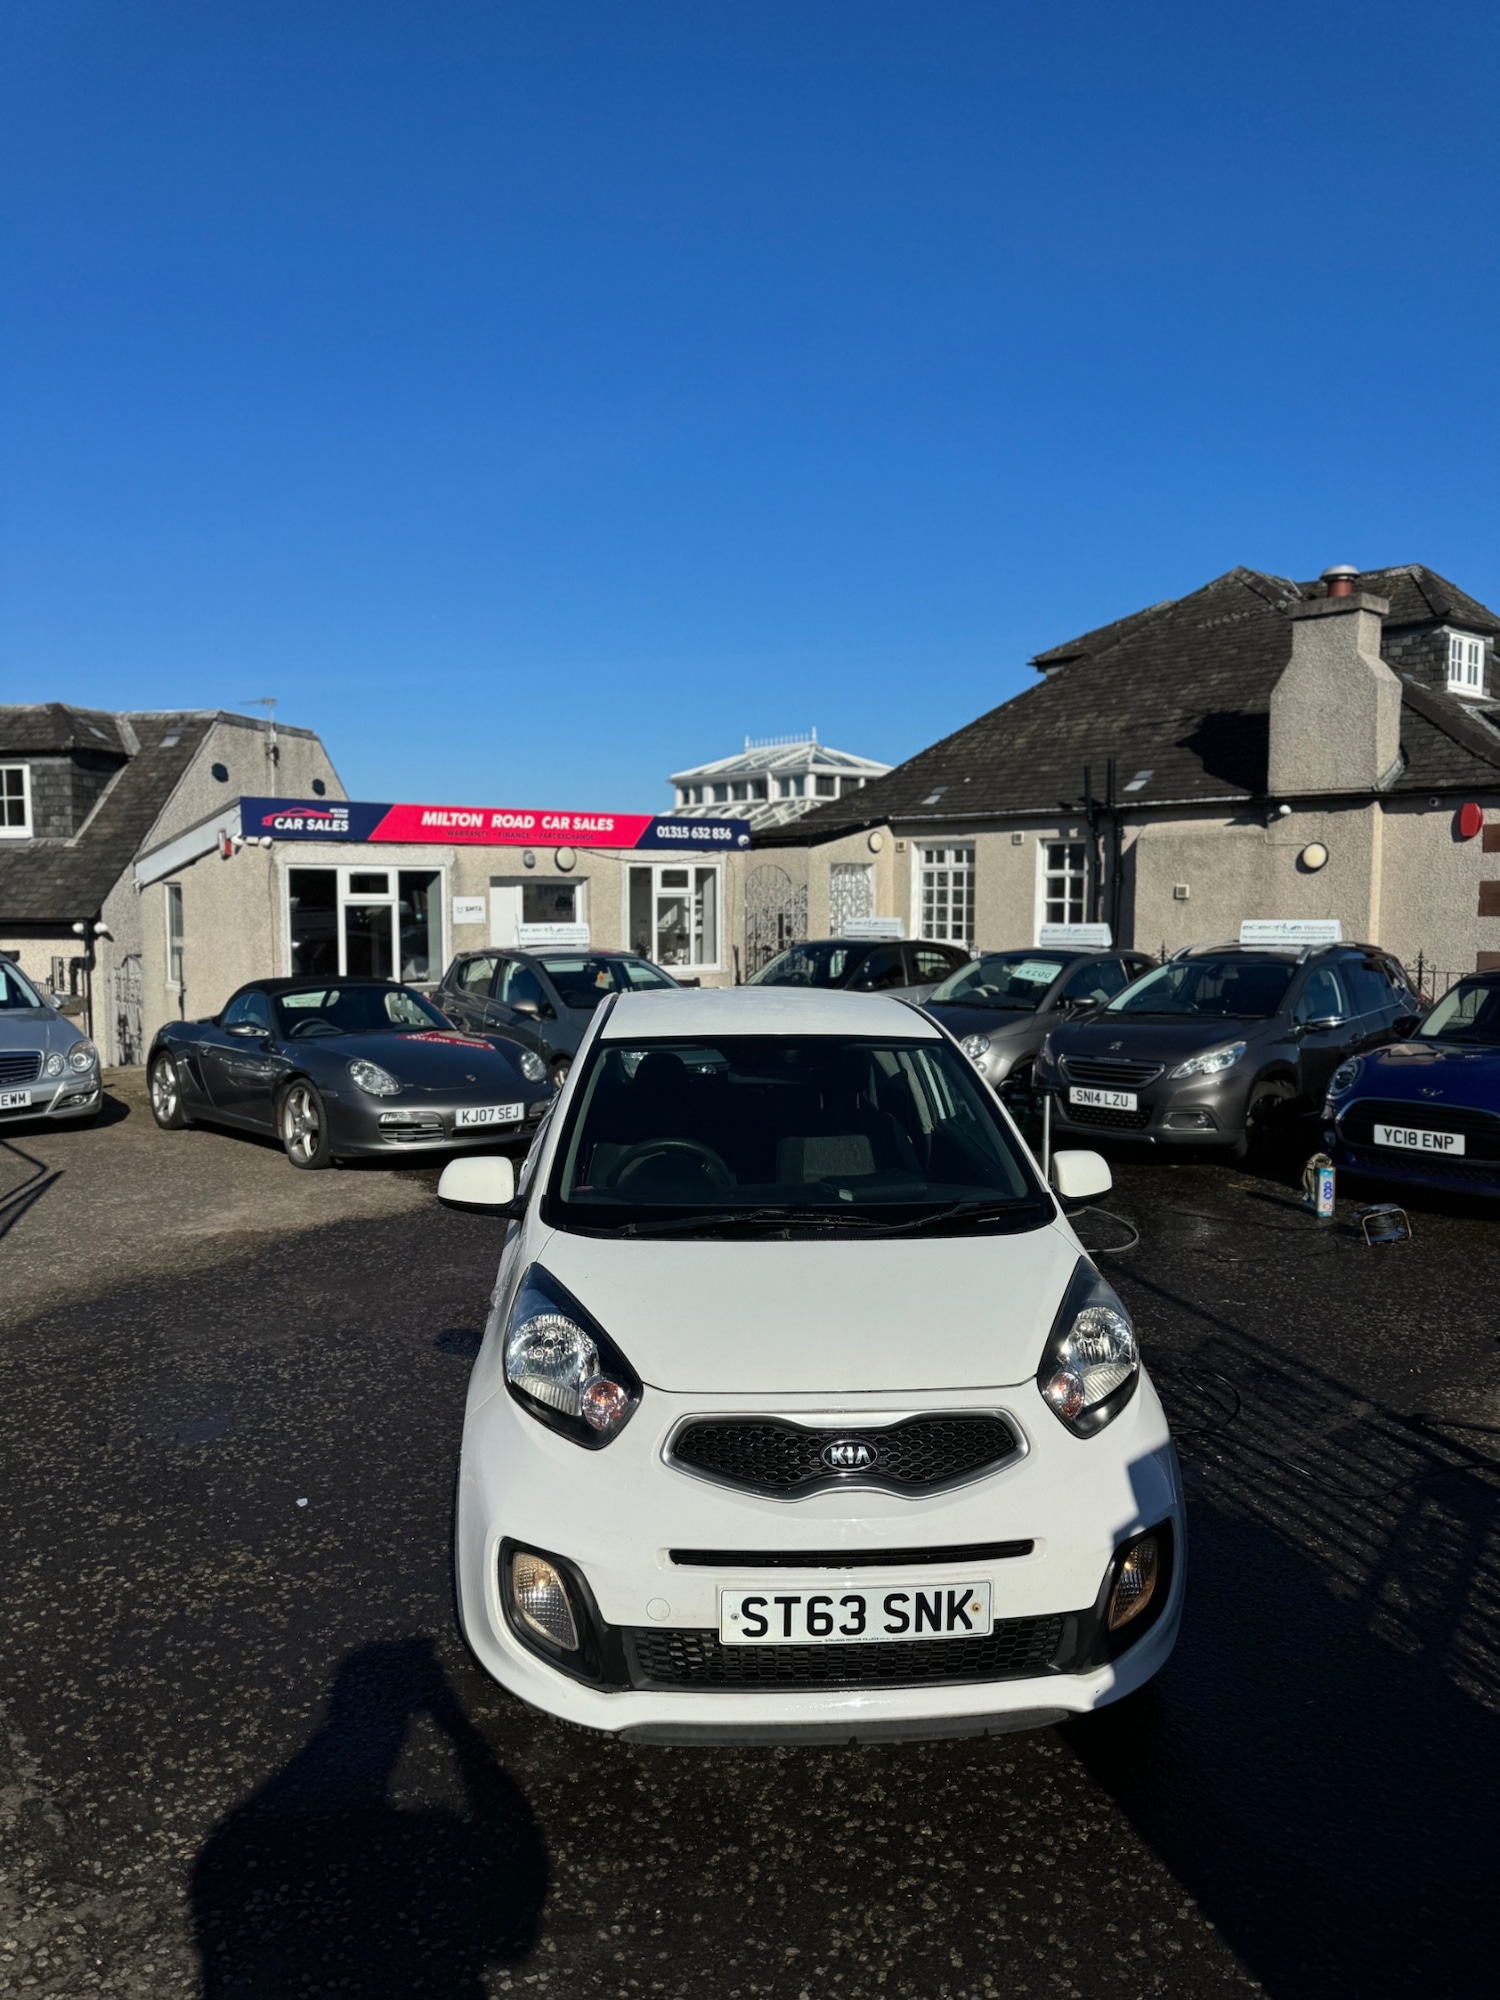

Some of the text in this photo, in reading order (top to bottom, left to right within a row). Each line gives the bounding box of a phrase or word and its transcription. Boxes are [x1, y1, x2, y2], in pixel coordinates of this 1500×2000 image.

[274, 817, 349, 832] CAR SALES
[421, 811, 614, 832] MILTON ROAD CAR SALES
[447, 829, 594, 841] WARRANTY FINANCE PART EXCHANGE
[656, 825, 732, 840] 01315 632 836
[1, 1092, 27, 1106] EWM
[1076, 1089, 1129, 1107] SN14 LZU
[462, 1105, 519, 1123] KJ07 SEJ
[1383, 1127, 1455, 1150] YC18 ENP
[830, 1446, 871, 1465] KIA
[741, 1588, 974, 1638] ST63 SNK
